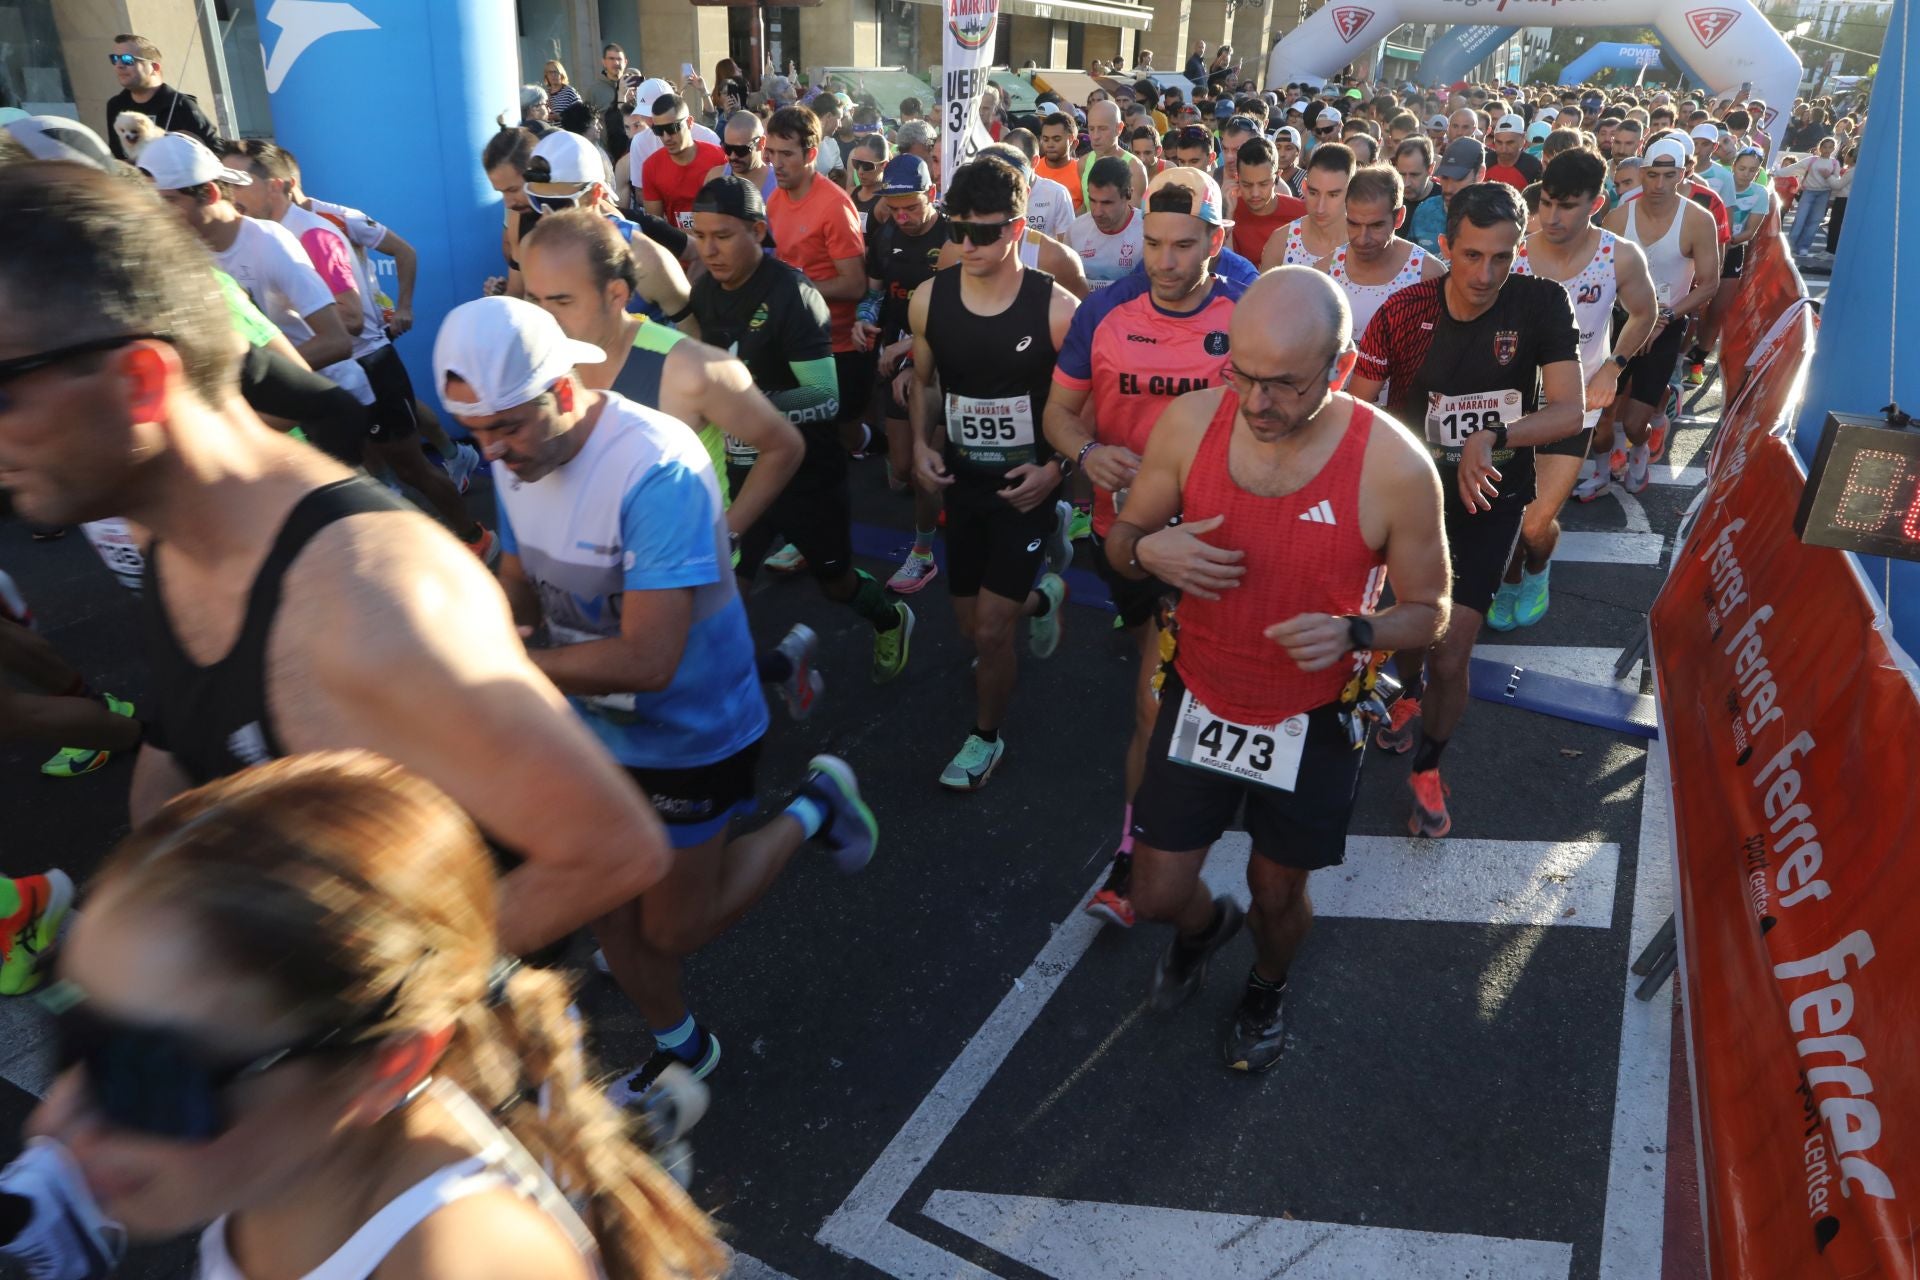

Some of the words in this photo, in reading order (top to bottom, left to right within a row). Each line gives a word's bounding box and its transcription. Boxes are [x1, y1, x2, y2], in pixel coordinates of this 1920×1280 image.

[1619, 47, 1660, 58] POWER
[1577, 284, 1602, 305] 20
[1120, 372, 1142, 396] EL
[1149, 376, 1209, 397] CLAN
[786, 397, 840, 425] ORTS
[1446, 402, 1456, 412] LA
[1459, 397, 1499, 411] MARATÓN
[962, 416, 1016, 440] 595
[1700, 517, 1748, 618] ferrer
[1724, 604, 1774, 736] ferrer
[1198, 719, 1276, 772] 473
[1732, 716, 1749, 755] center
[1200, 756, 1232, 771] MIGUEL
[1234, 766, 1264, 781] ANGEL
[1753, 730, 1832, 908] ferrer
[1750, 870, 1769, 922] center
[1773, 929, 1897, 1200] ferrer
[1803, 1133, 1829, 1219] center
